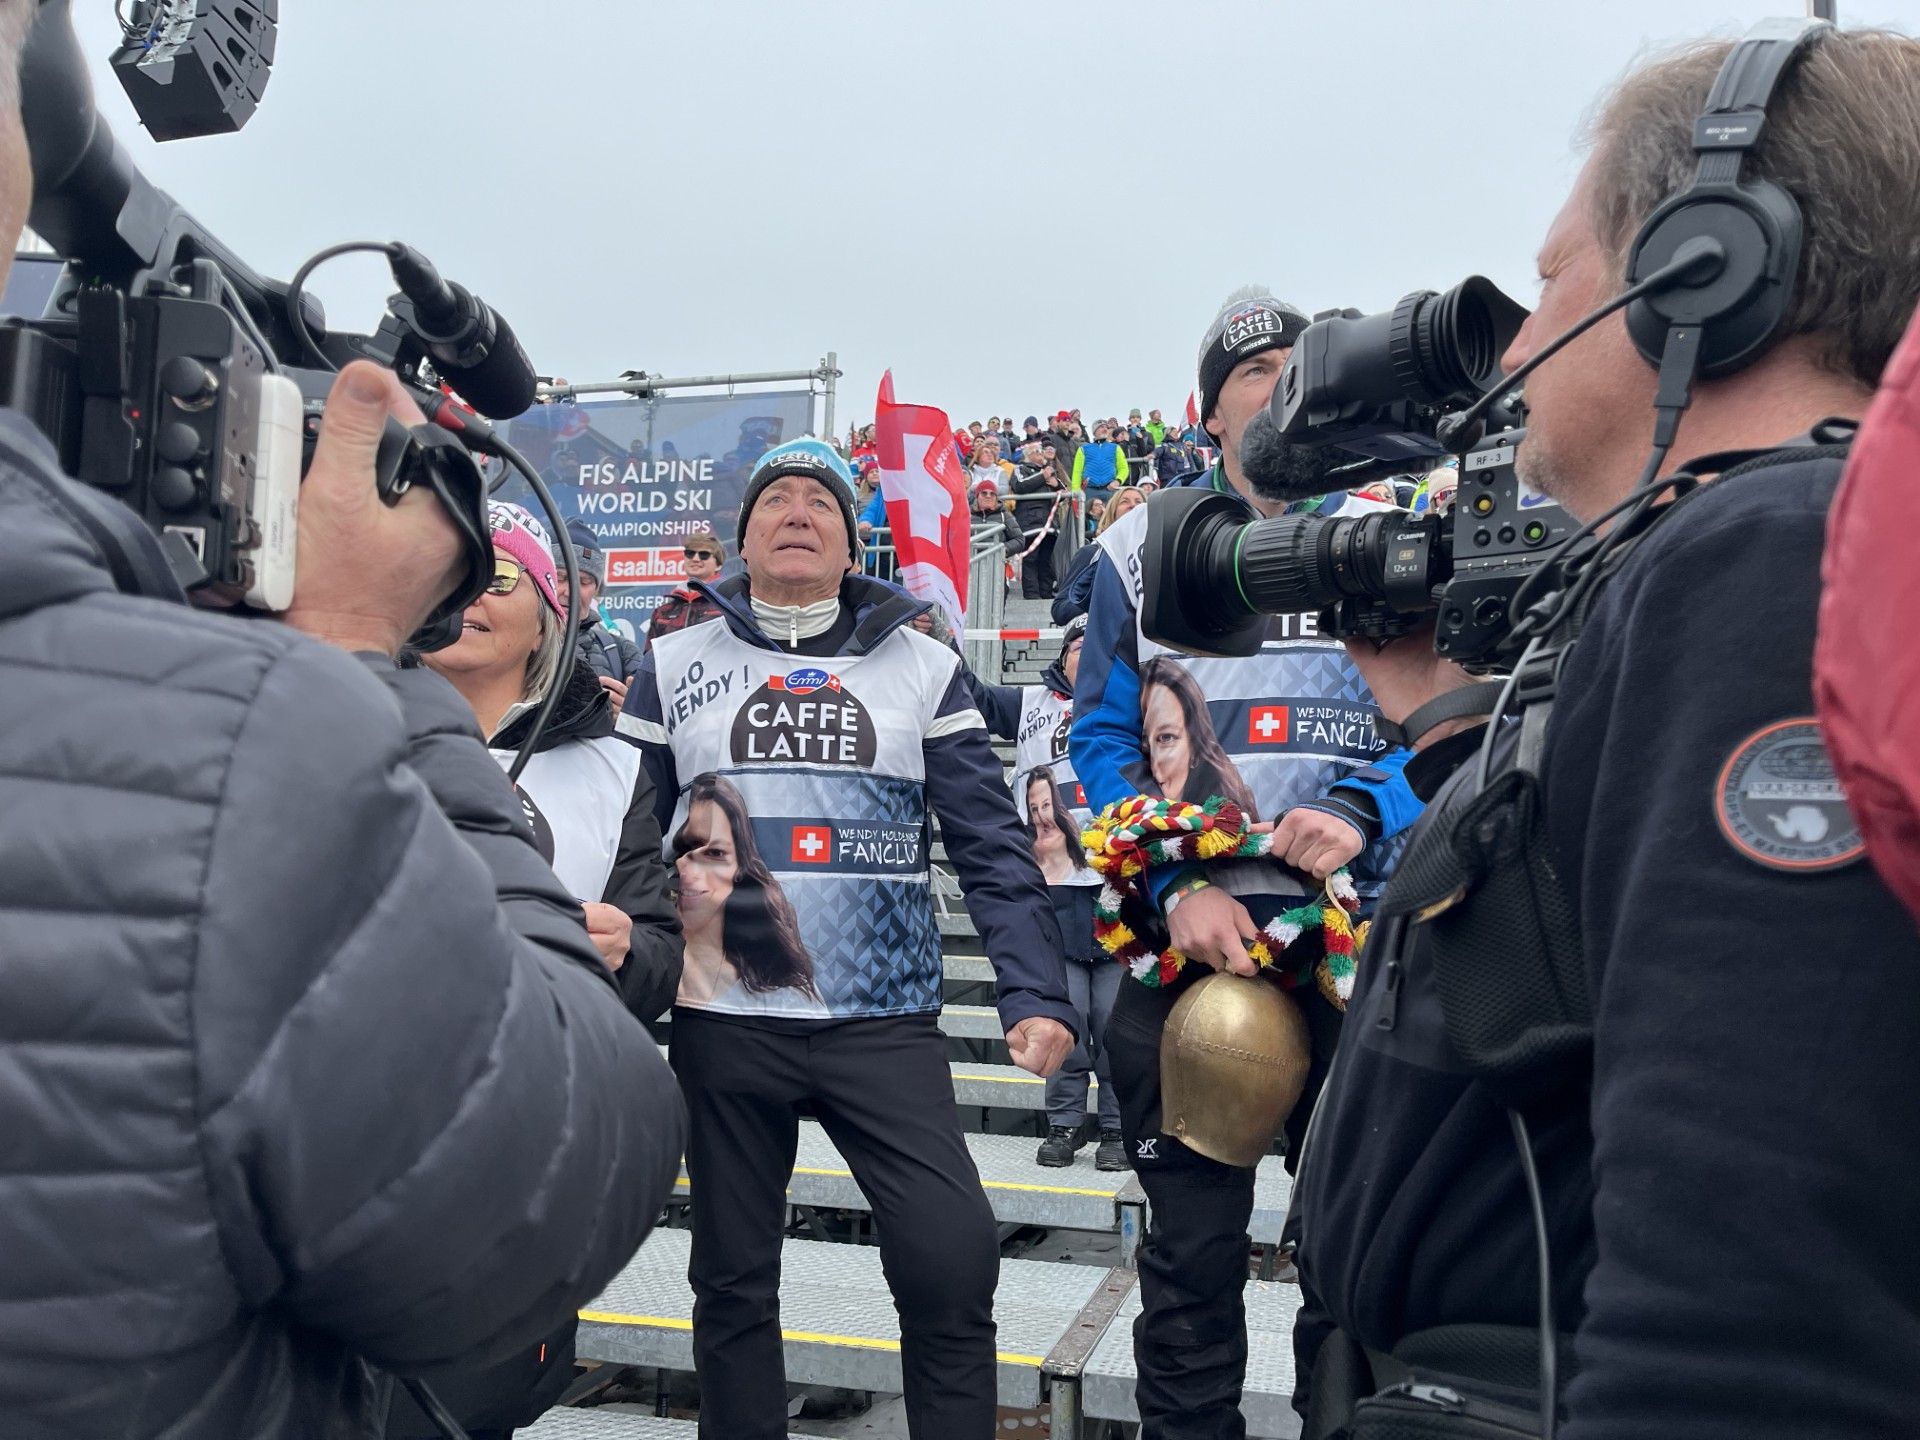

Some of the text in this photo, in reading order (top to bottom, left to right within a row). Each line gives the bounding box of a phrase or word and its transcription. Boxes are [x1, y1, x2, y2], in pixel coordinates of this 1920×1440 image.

[1228, 310, 1272, 334] CAFFÈ
[1230, 321, 1273, 344] LATTE
[578, 459, 714, 486] FIS ALPINE
[577, 489, 712, 514] WORLD SKI
[587, 520, 711, 537] HAMPIONSHIPS
[788, 673, 826, 686] Emmi
[747, 699, 858, 731] CAFFÈ
[1026, 707, 1041, 723] GO
[1296, 706, 1341, 720] WENDY
[1019, 713, 1053, 744] WENDY
[747, 732, 857, 761] LATTE
[838, 828, 878, 840] WENDY
[838, 841, 919, 865] FANCLU
